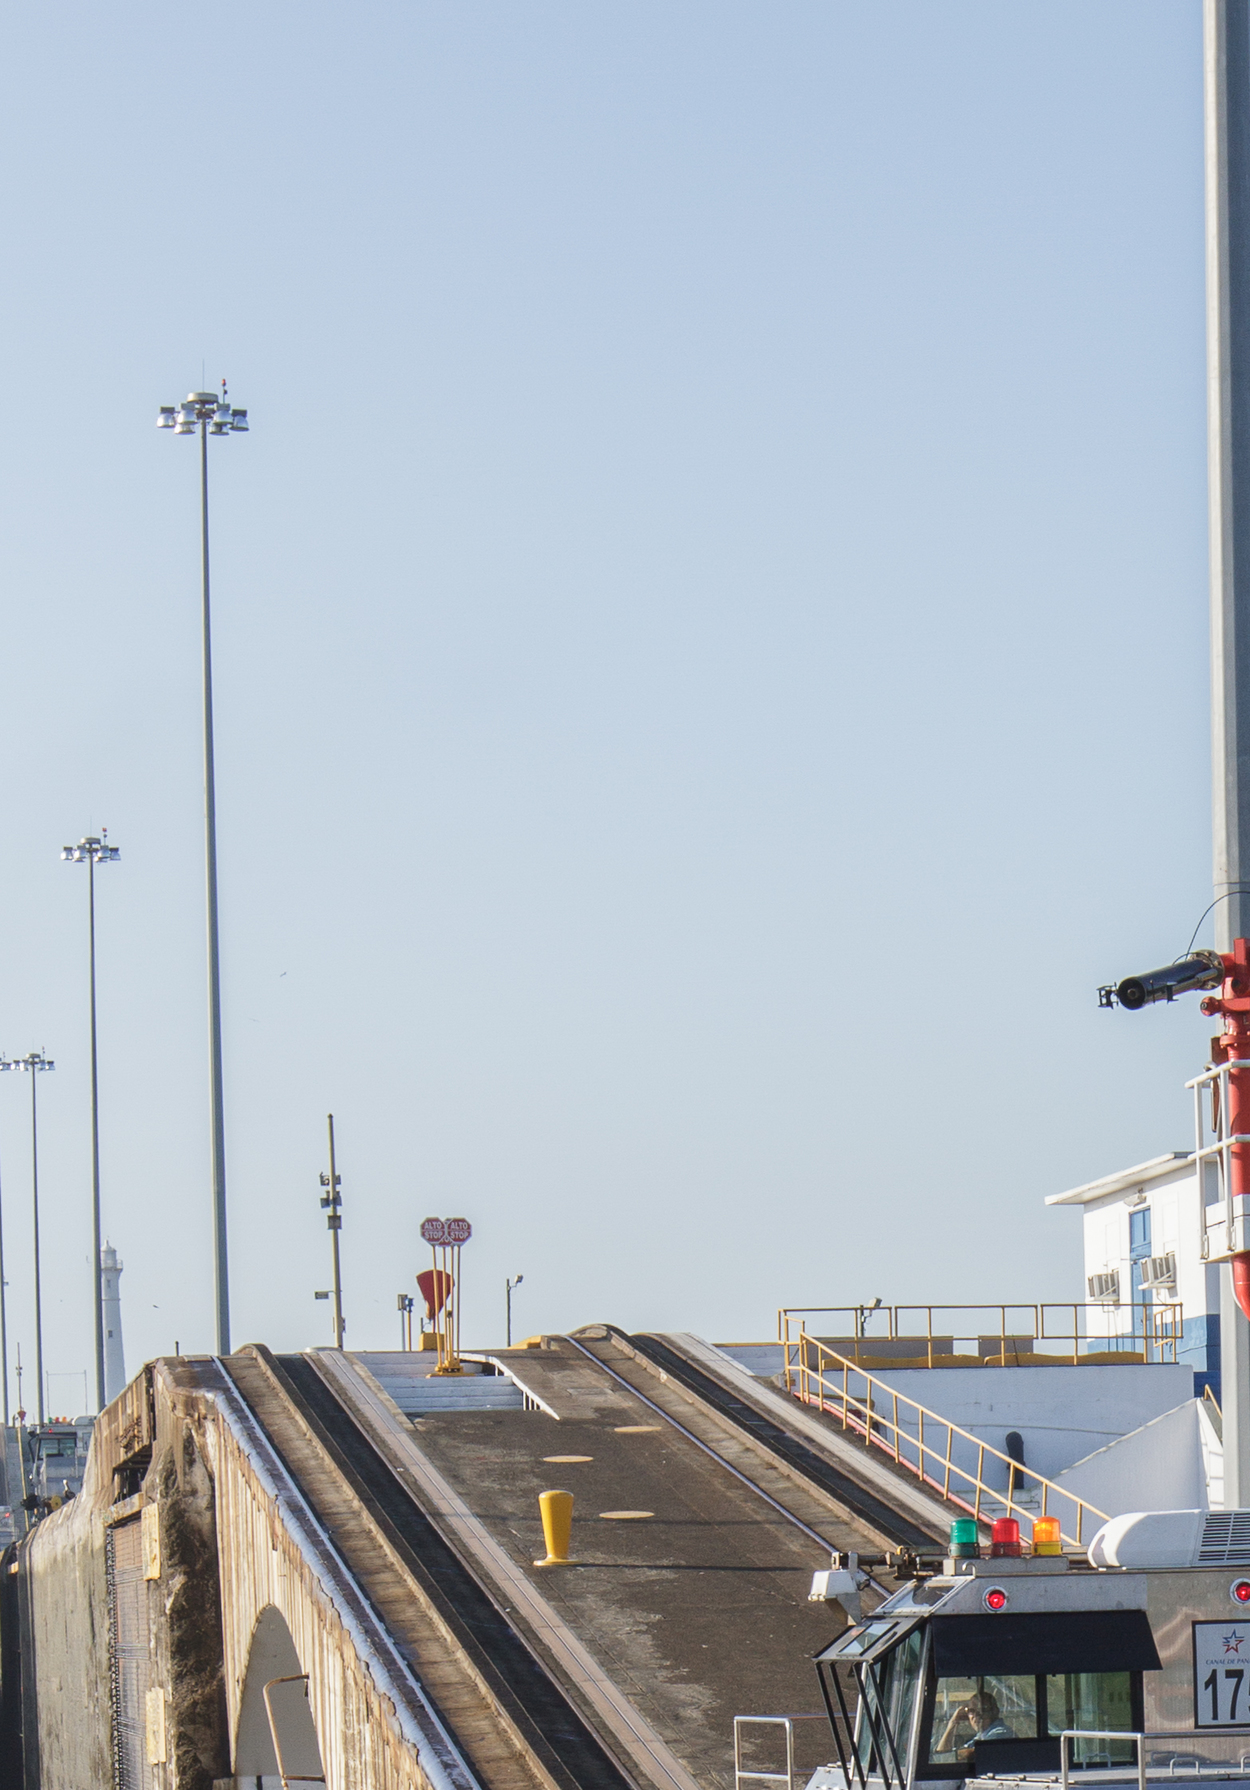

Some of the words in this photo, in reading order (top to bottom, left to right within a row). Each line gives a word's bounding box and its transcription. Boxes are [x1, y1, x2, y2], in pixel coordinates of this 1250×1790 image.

[424, 1221, 442, 1230] ALTO
[450, 1222, 468, 1230] ALTO
[424, 1231, 443, 1239] STOP
[450, 1231, 468, 1239] STOP
